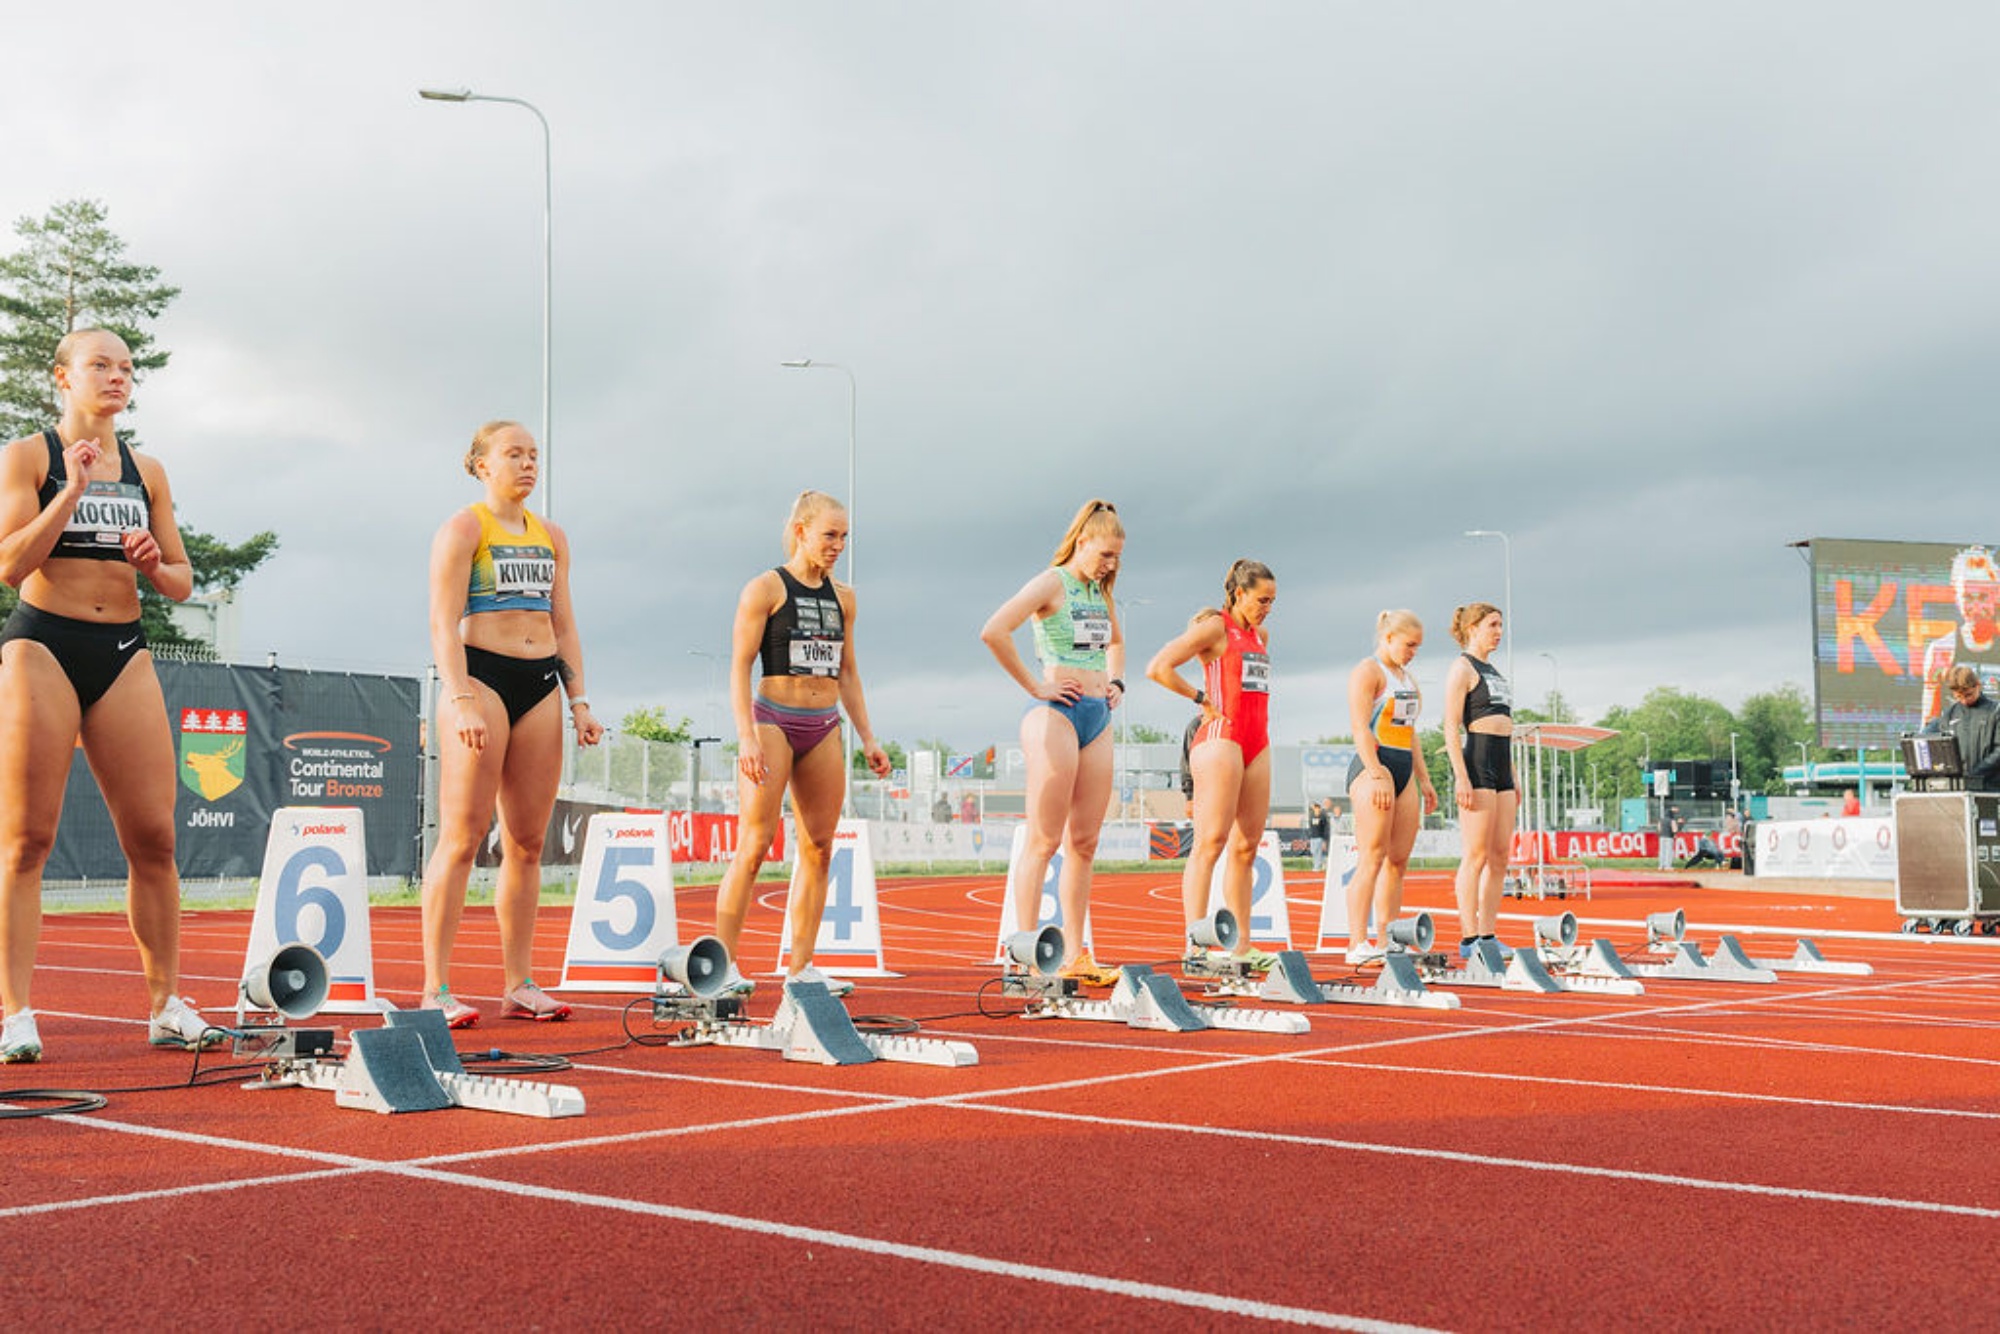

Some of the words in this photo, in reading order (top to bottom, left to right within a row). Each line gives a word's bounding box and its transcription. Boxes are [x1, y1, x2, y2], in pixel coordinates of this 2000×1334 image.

[290, 778, 324, 797] Tour
[326, 779, 383, 797] Bronze
[291, 758, 383, 778] Continental
[187, 808, 235, 827] JÕHVI
[275, 846, 347, 960] 6
[591, 847, 655, 950] 5
[821, 847, 862, 940] 4
